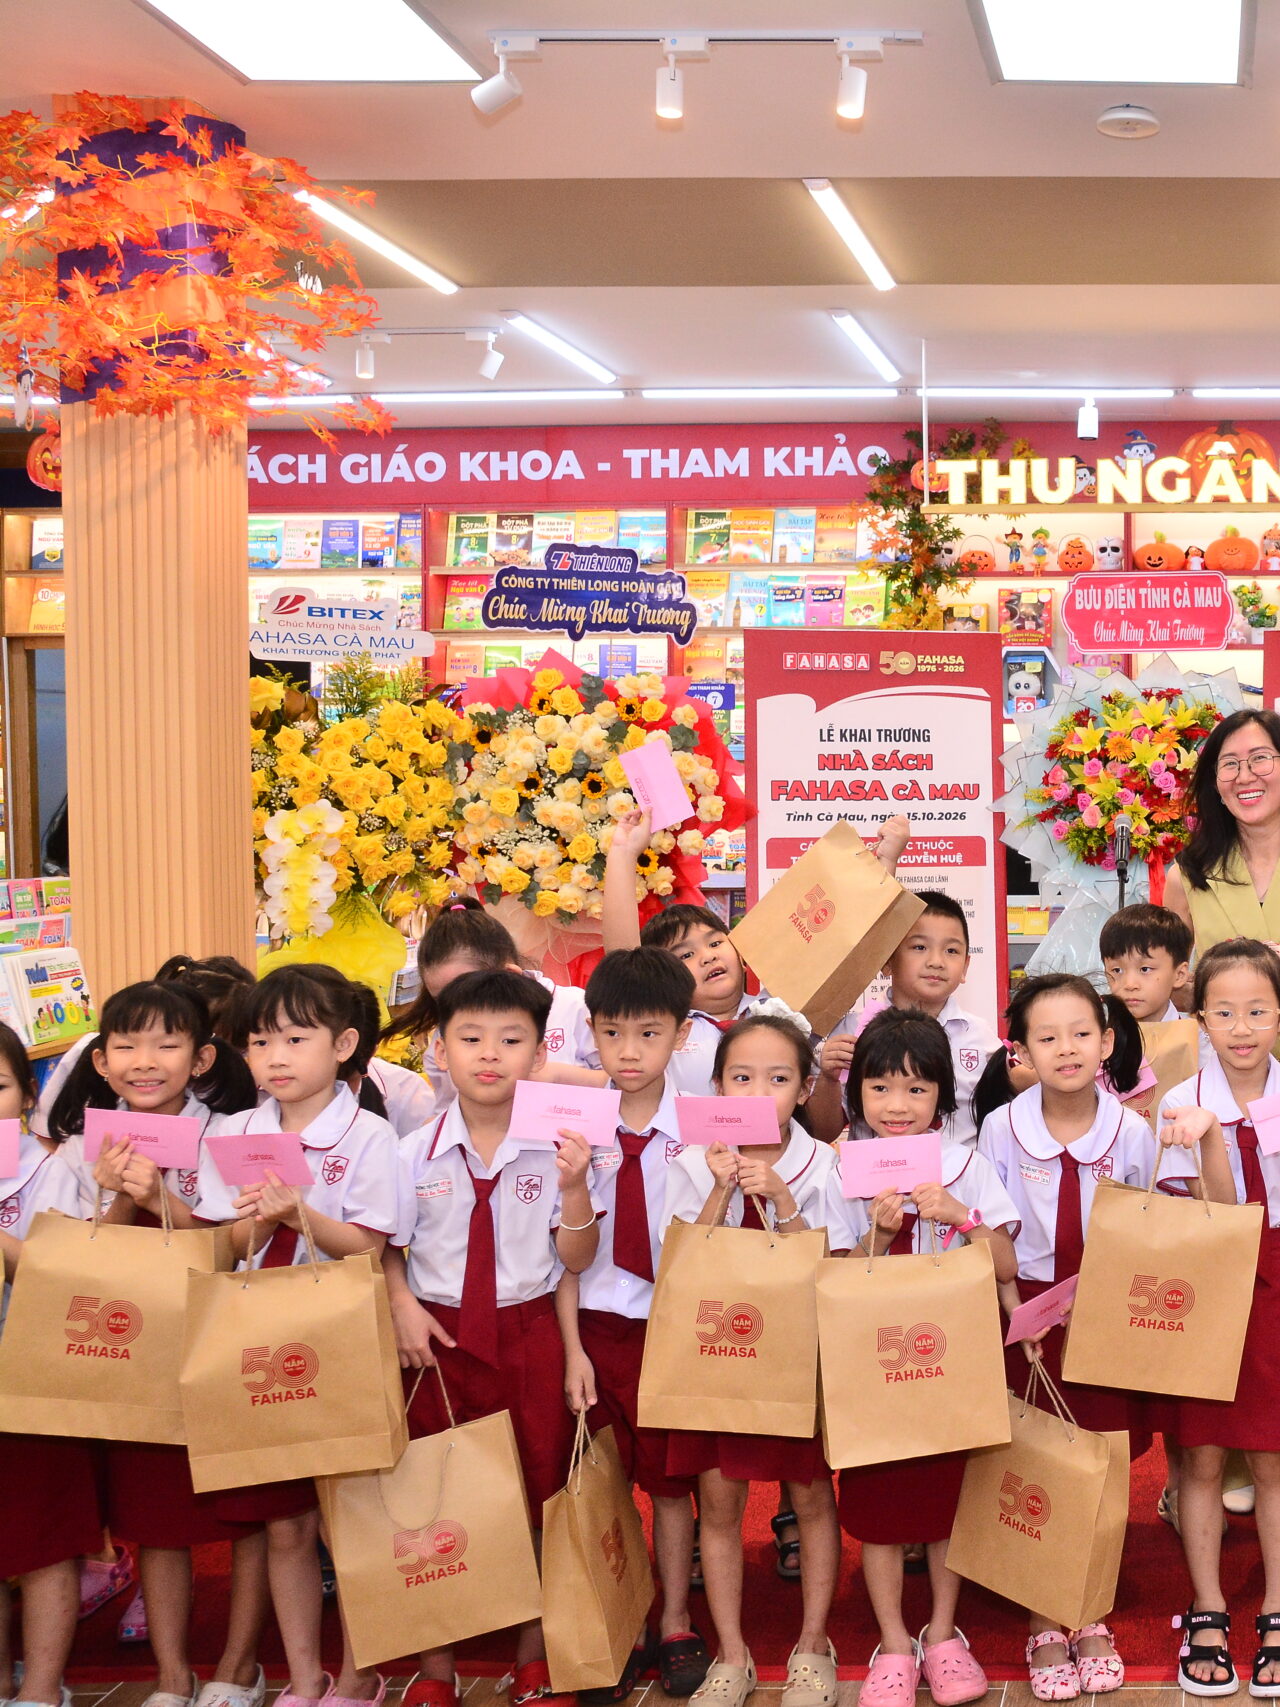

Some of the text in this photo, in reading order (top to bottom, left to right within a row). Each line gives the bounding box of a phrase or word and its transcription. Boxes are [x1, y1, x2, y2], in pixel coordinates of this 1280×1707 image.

[247, 445, 327, 484] ÁCH
[340, 443, 447, 484] GIÁO
[460, 449, 585, 482] KHOA
[623, 447, 749, 479] THAM
[764, 433, 890, 477] KHẢO
[936, 457, 1076, 504] THU
[501, 575, 535, 589] CÔNG
[536, 577, 551, 589] TY
[552, 576, 585, 591] THIÊN
[588, 579, 621, 592] LONG
[622, 578, 655, 593] HOÀN
[1075, 579, 1222, 615] BƯU ĐIỆN TỈNH CÀ MAU
[307, 606, 385, 621] BITEX
[488, 594, 692, 637] Chúc Mừng Khai Trương
[278, 619, 382, 632] Chúc Mừng Nhà Sách
[1094, 619, 1205, 646] Chúc Mừng Khai Trương
[249, 630, 415, 650] AHASA CÀ MAU
[784, 653, 869, 670] FAHASA
[879, 651, 965, 675] 50 FAHASA
[819, 723, 931, 743] LỄ KHAI TRƯƠNG
[817, 749, 934, 770] NHÀ SÁCH
[770, 779, 980, 801] FAHASA CÀ MAU
[786, 811, 967, 823] Tỉnh Cà Mau, ngà 15.10.2026
[799, 841, 814, 851] CÁ
[915, 839, 954, 852] THUỘC
[940, 852, 963, 865] HUỆ
[904, 875, 925, 883] FAHASA
[925, 875, 936, 883] CAO
[787, 913, 812, 944] FAHASA
[714, 1115, 742, 1124] fahasa
[880, 1158, 907, 1168] fahasa
[1127, 1274, 1195, 1321] 50
[65, 1296, 143, 1347] 50
[695, 1299, 764, 1346] 50
[1129, 1316, 1184, 1332] FAHASA
[66, 1343, 131, 1360] FAHASA
[699, 1344, 757, 1359] FAHASA
[878, 1322, 947, 1371] 50
[242, 1342, 320, 1393] 50
[885, 1365, 945, 1383] FAHASA
[250, 1386, 317, 1406] FAHASA
[998, 1471, 1051, 1527] 50
[999, 1512, 1042, 1541] FAHASA
[393, 1519, 468, 1575] 50
[405, 1561, 468, 1588] FAHASA
